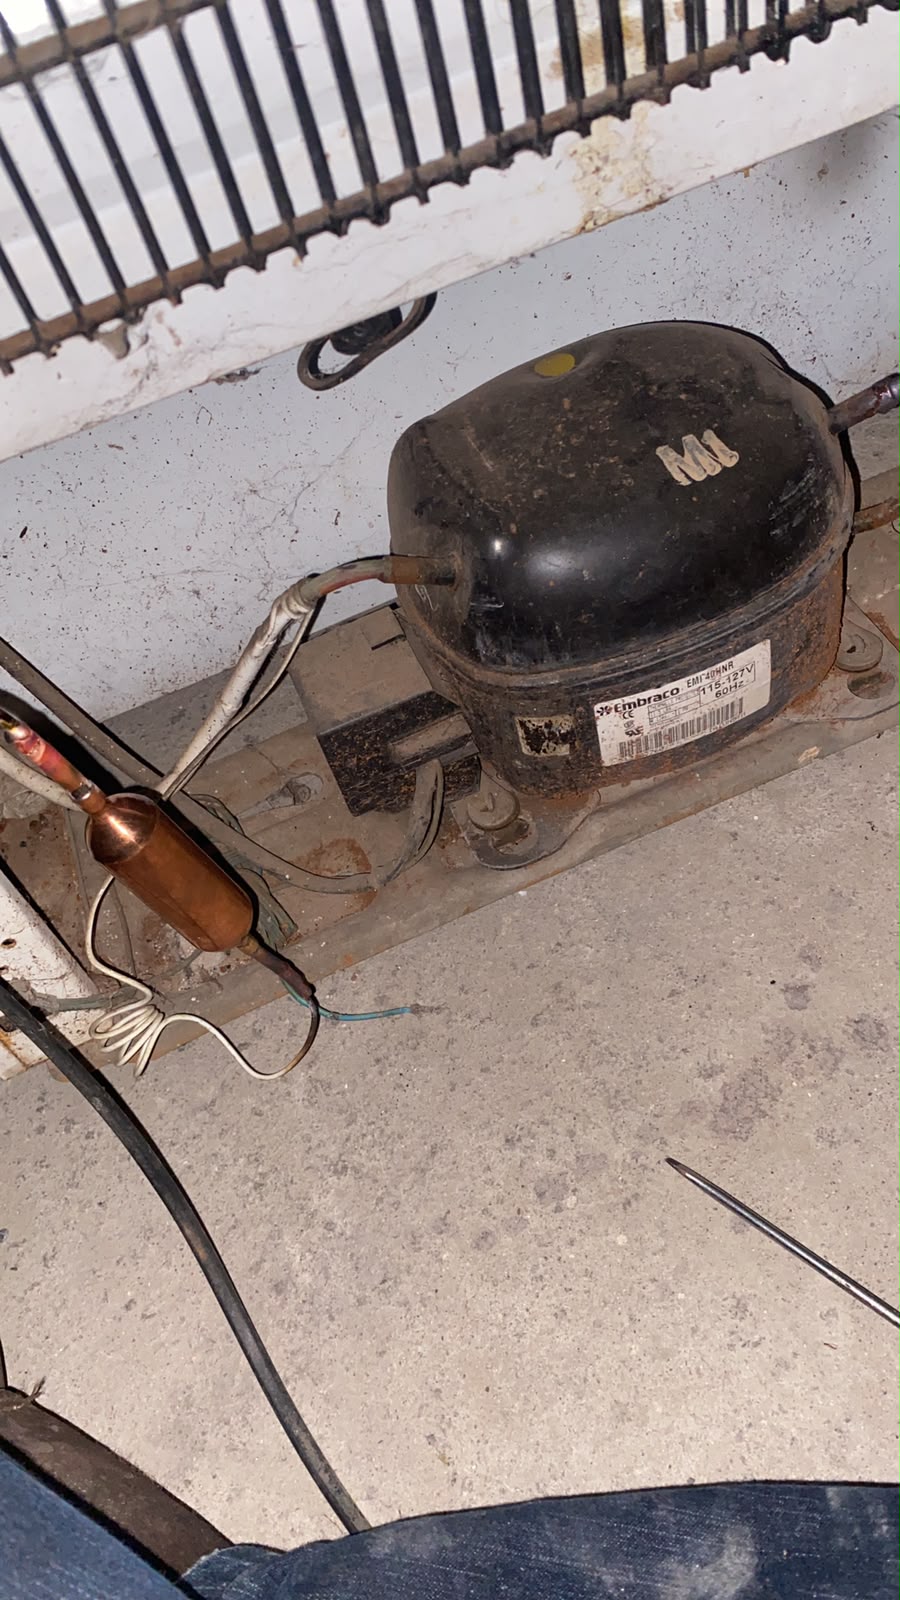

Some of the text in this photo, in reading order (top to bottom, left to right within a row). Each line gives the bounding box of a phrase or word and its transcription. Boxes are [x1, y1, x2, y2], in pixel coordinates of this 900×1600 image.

[701, 664, 754, 695] 115-127V
[715, 681, 744, 698] 60Hz
[614, 687, 680, 713] Embraco
